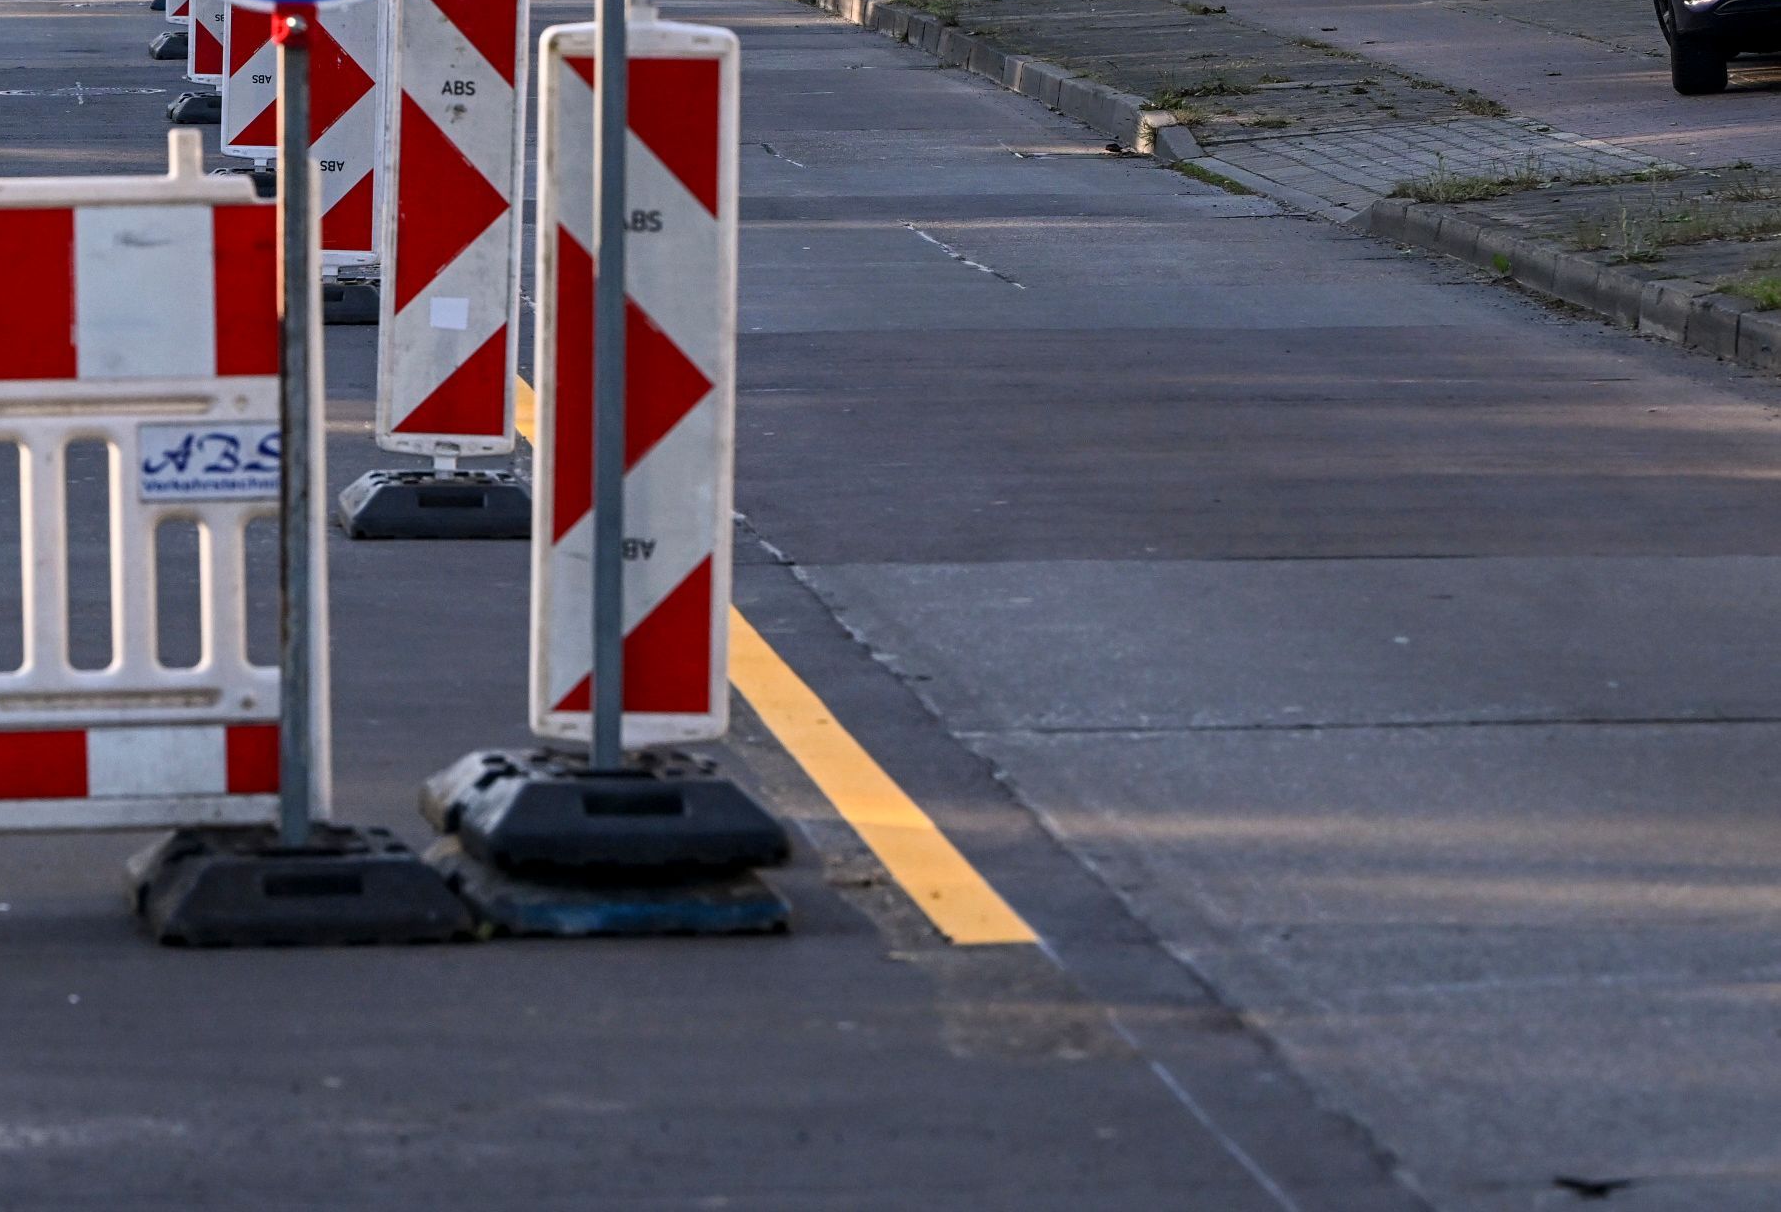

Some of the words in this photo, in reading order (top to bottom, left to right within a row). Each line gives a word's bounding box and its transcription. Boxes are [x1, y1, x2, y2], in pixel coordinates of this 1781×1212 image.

[252, 74, 273, 84] ABS
[440, 79, 476, 96] ABS
[319, 160, 345, 172] ABS
